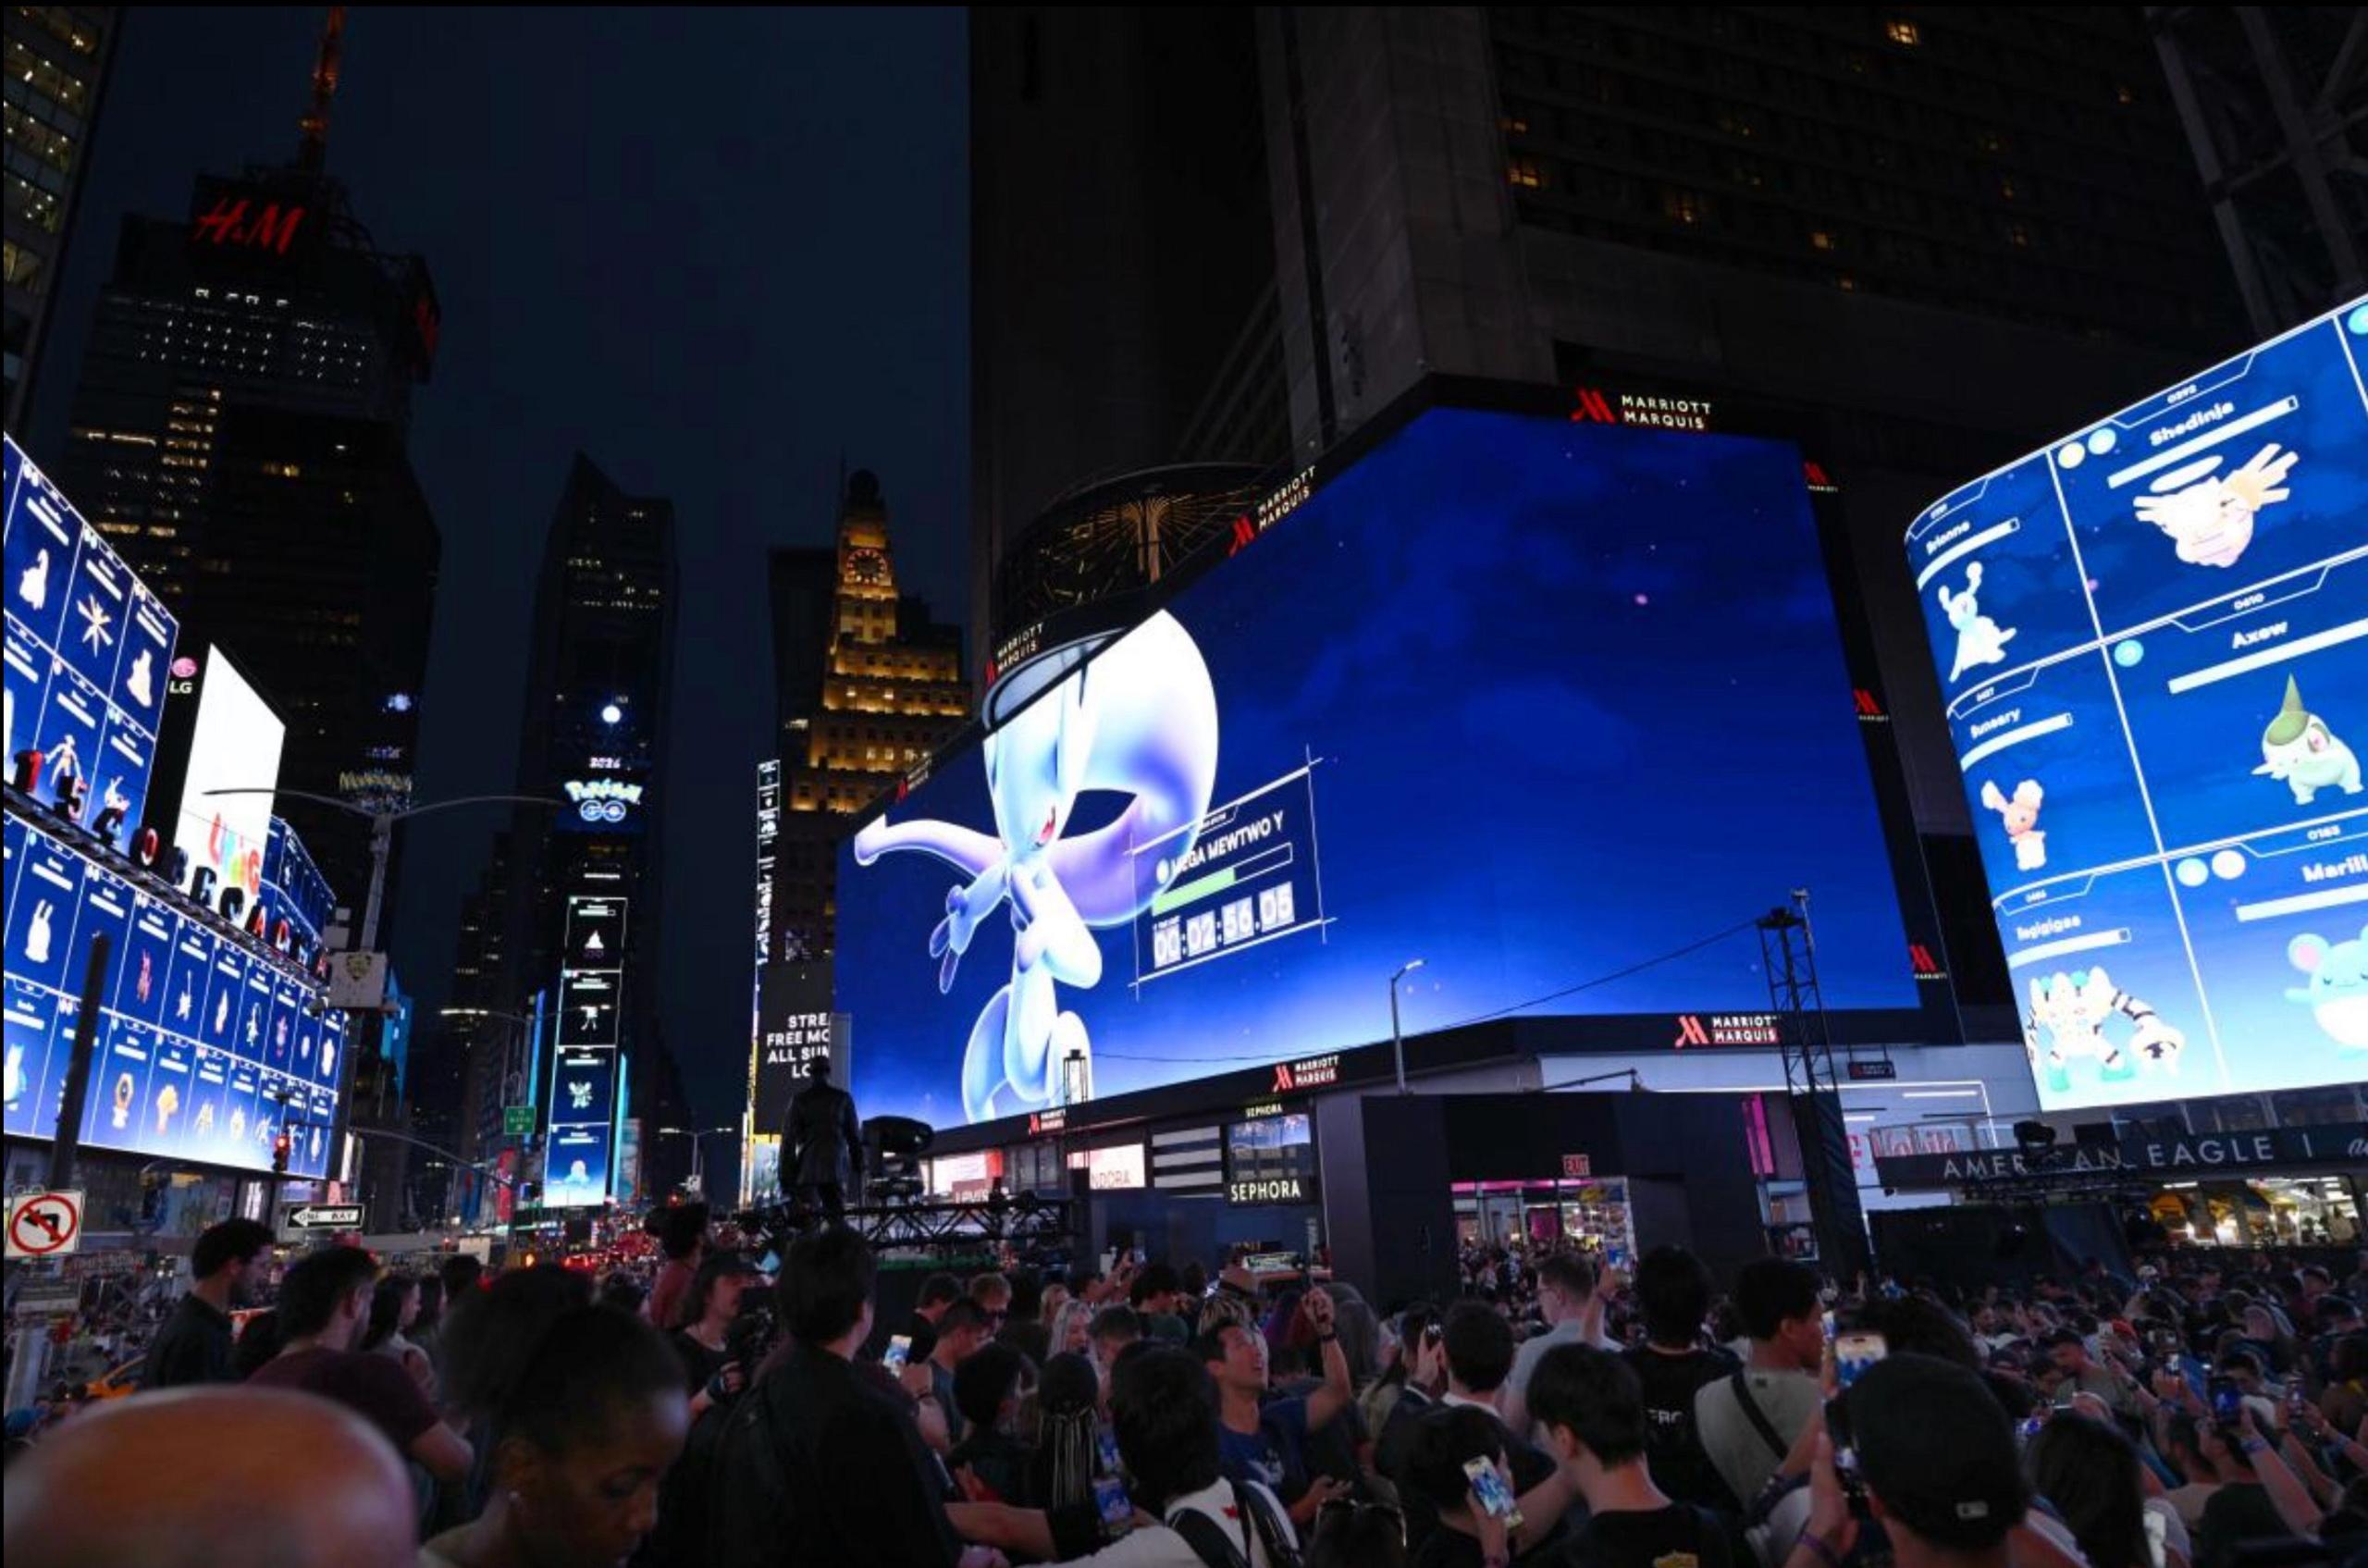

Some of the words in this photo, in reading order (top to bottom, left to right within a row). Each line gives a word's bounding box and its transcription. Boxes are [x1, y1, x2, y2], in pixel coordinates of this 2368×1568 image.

[195, 197, 304, 253] H&M
[1621, 395, 1711, 414] MARRIOTT
[1623, 411, 1706, 430] MARQUIS
[1258, 465, 1315, 515] MARRIOTT
[1259, 486, 1311, 531] MARQUIS
[2232, 622, 2288, 649] Axew
[169, 681, 192, 694] LG
[1207, 818, 1271, 861] MEWTWO
[1273, 810, 1284, 832] Y
[2301, 854, 2368, 883] Marill
[788, 1013, 830, 1029] STRE
[766, 1031, 802, 1047] FREE
[1715, 1029, 1777, 1043] MARQUIS
[767, 1048, 796, 1065] ALL
[1295, 1056, 1339, 1072] MARRIOTT
[1245, 1104, 1282, 1117] SEPHORA
[1943, 1147, 2124, 1181] AMERAN
[2149, 1135, 2275, 1167] EAGLE
[1230, 1179, 1301, 1203] SEPHORA
[331, 1212, 353, 1222] WAY
